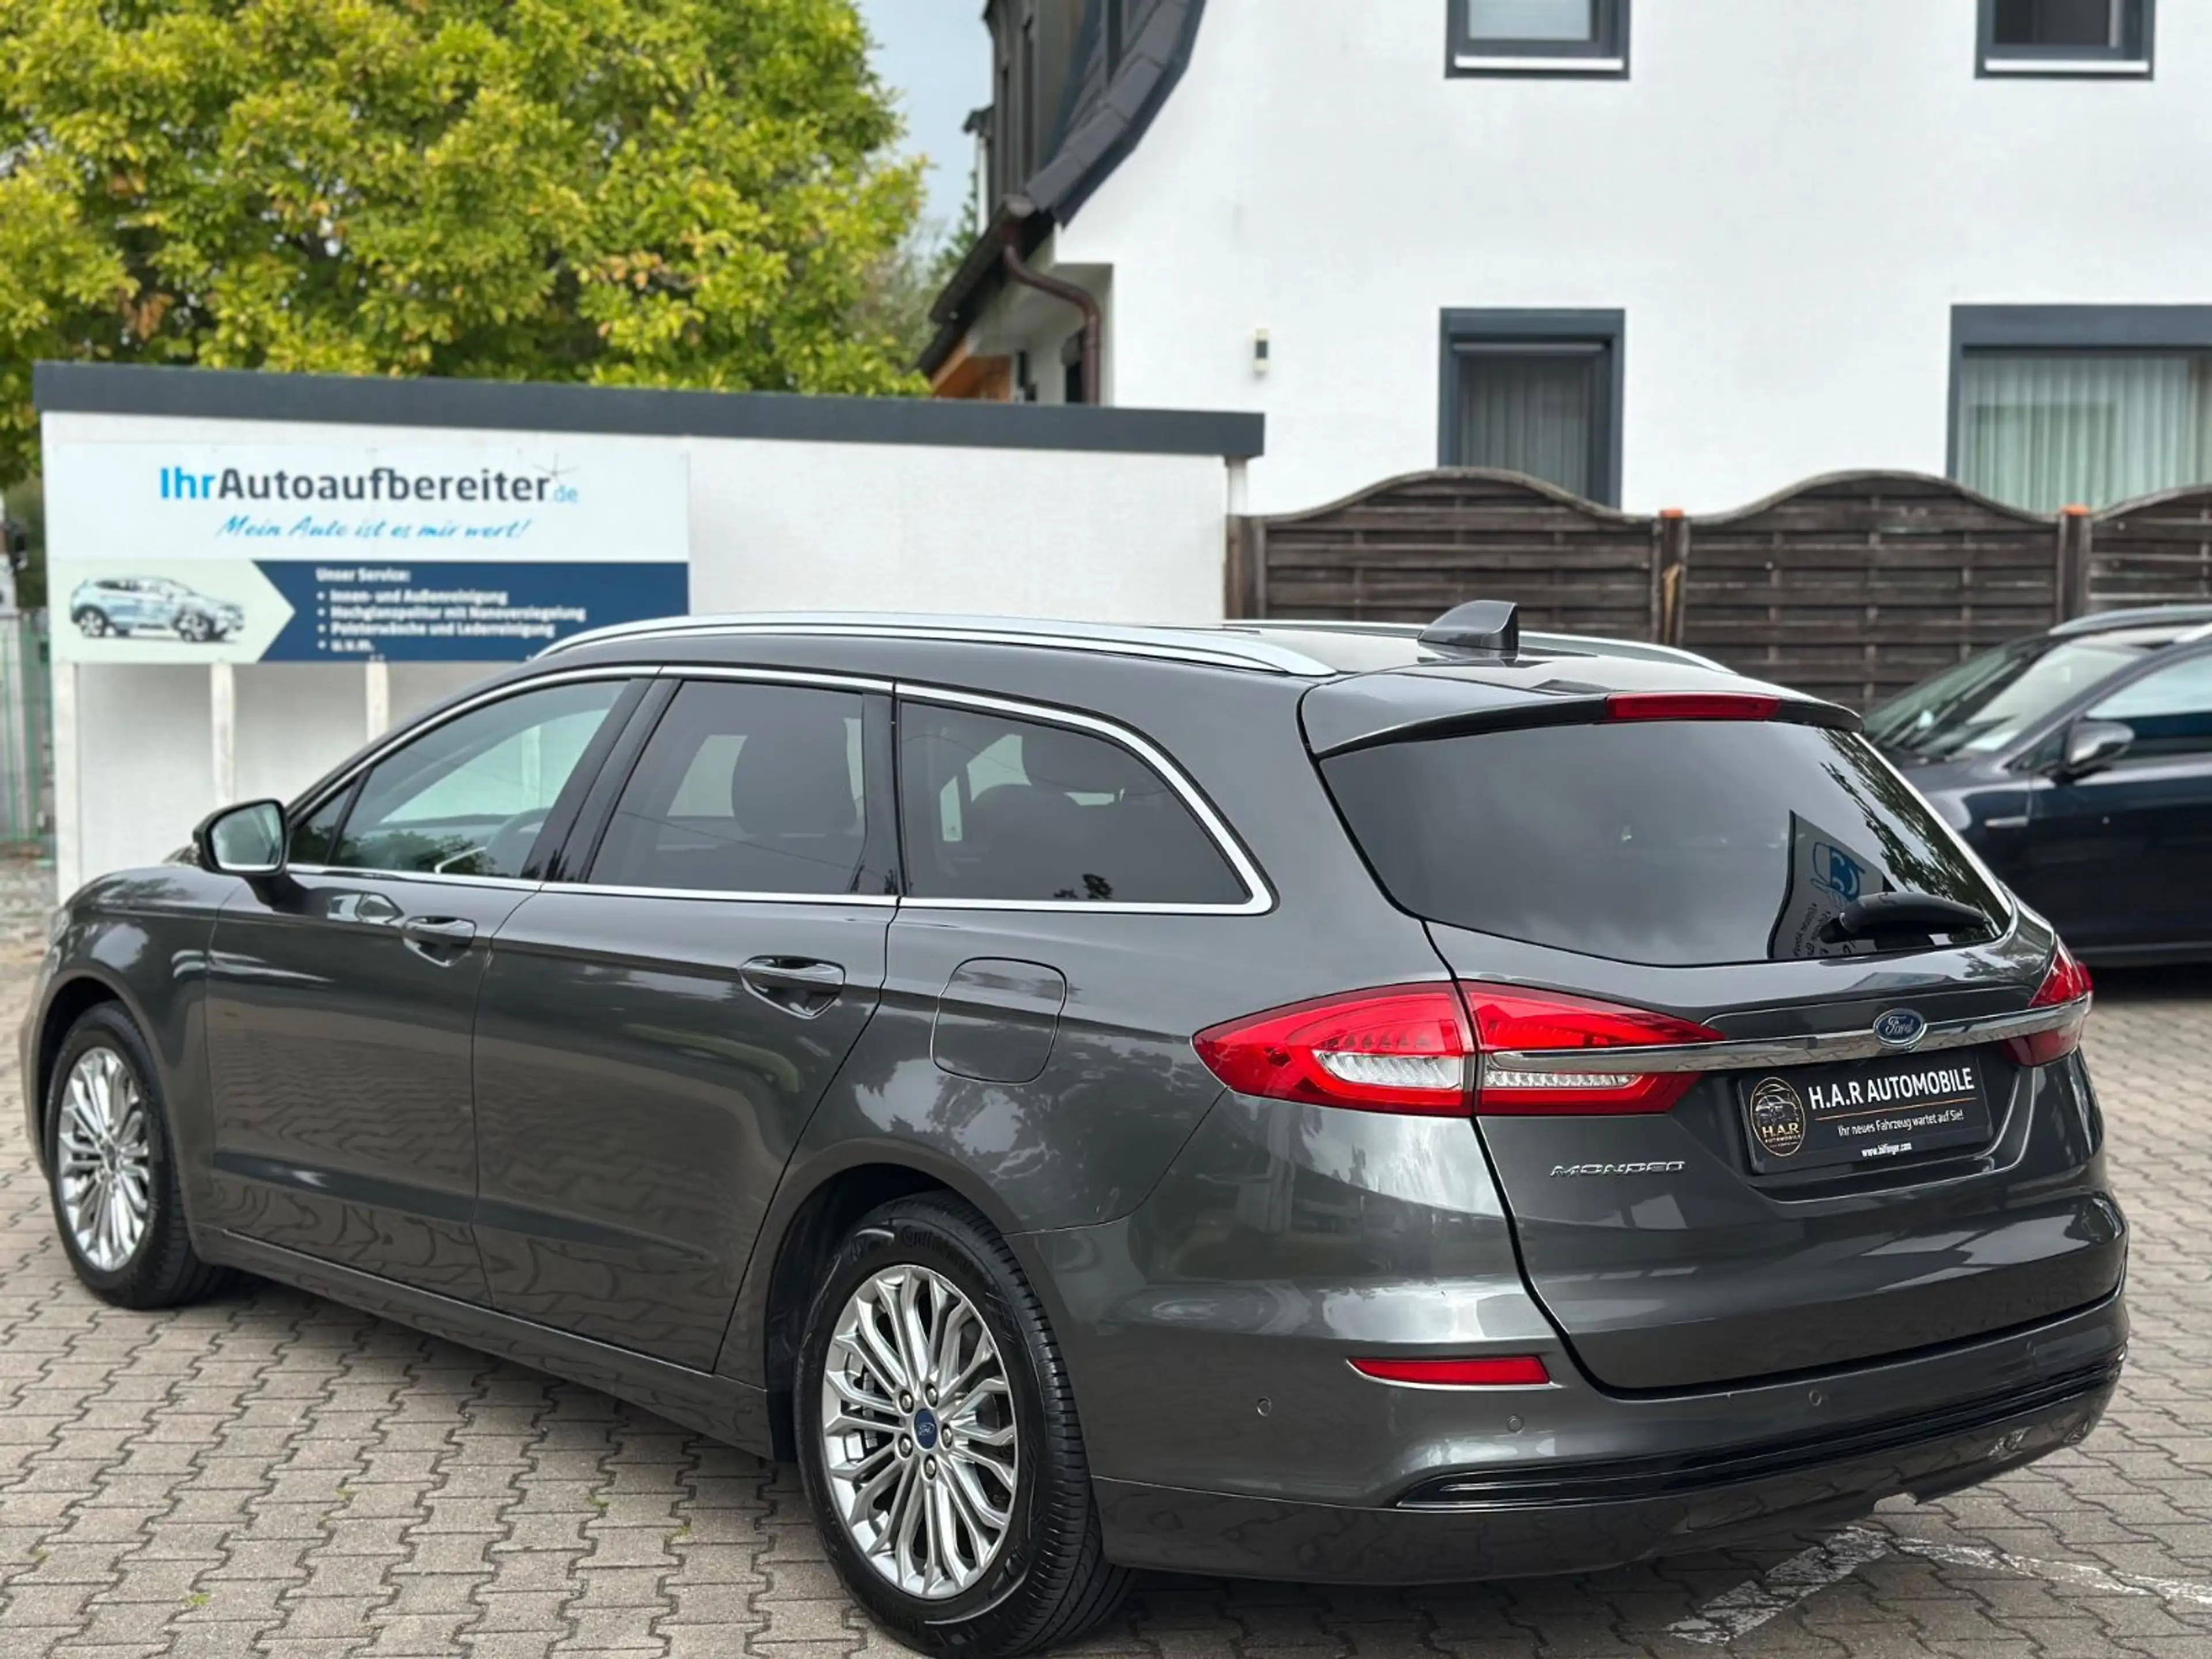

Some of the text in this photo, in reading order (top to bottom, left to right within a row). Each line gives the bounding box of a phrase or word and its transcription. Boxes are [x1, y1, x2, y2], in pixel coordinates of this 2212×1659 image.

[216, 514, 533, 538] Mein Auto ist es mir wert!
[316, 567, 355, 582] Unser
[1885, 1016, 1914, 1036] Ford
[1808, 1067, 1975, 1109] H.A.R AUTOMOBILE
[1851, 1123, 1876, 1135] neues
[1876, 1118, 1912, 1131] Fahrzeug
[1911, 1113, 1937, 1126] wartet
[1937, 1109, 1950, 1123] auf
[1550, 1161, 1685, 1177] MONDEO
